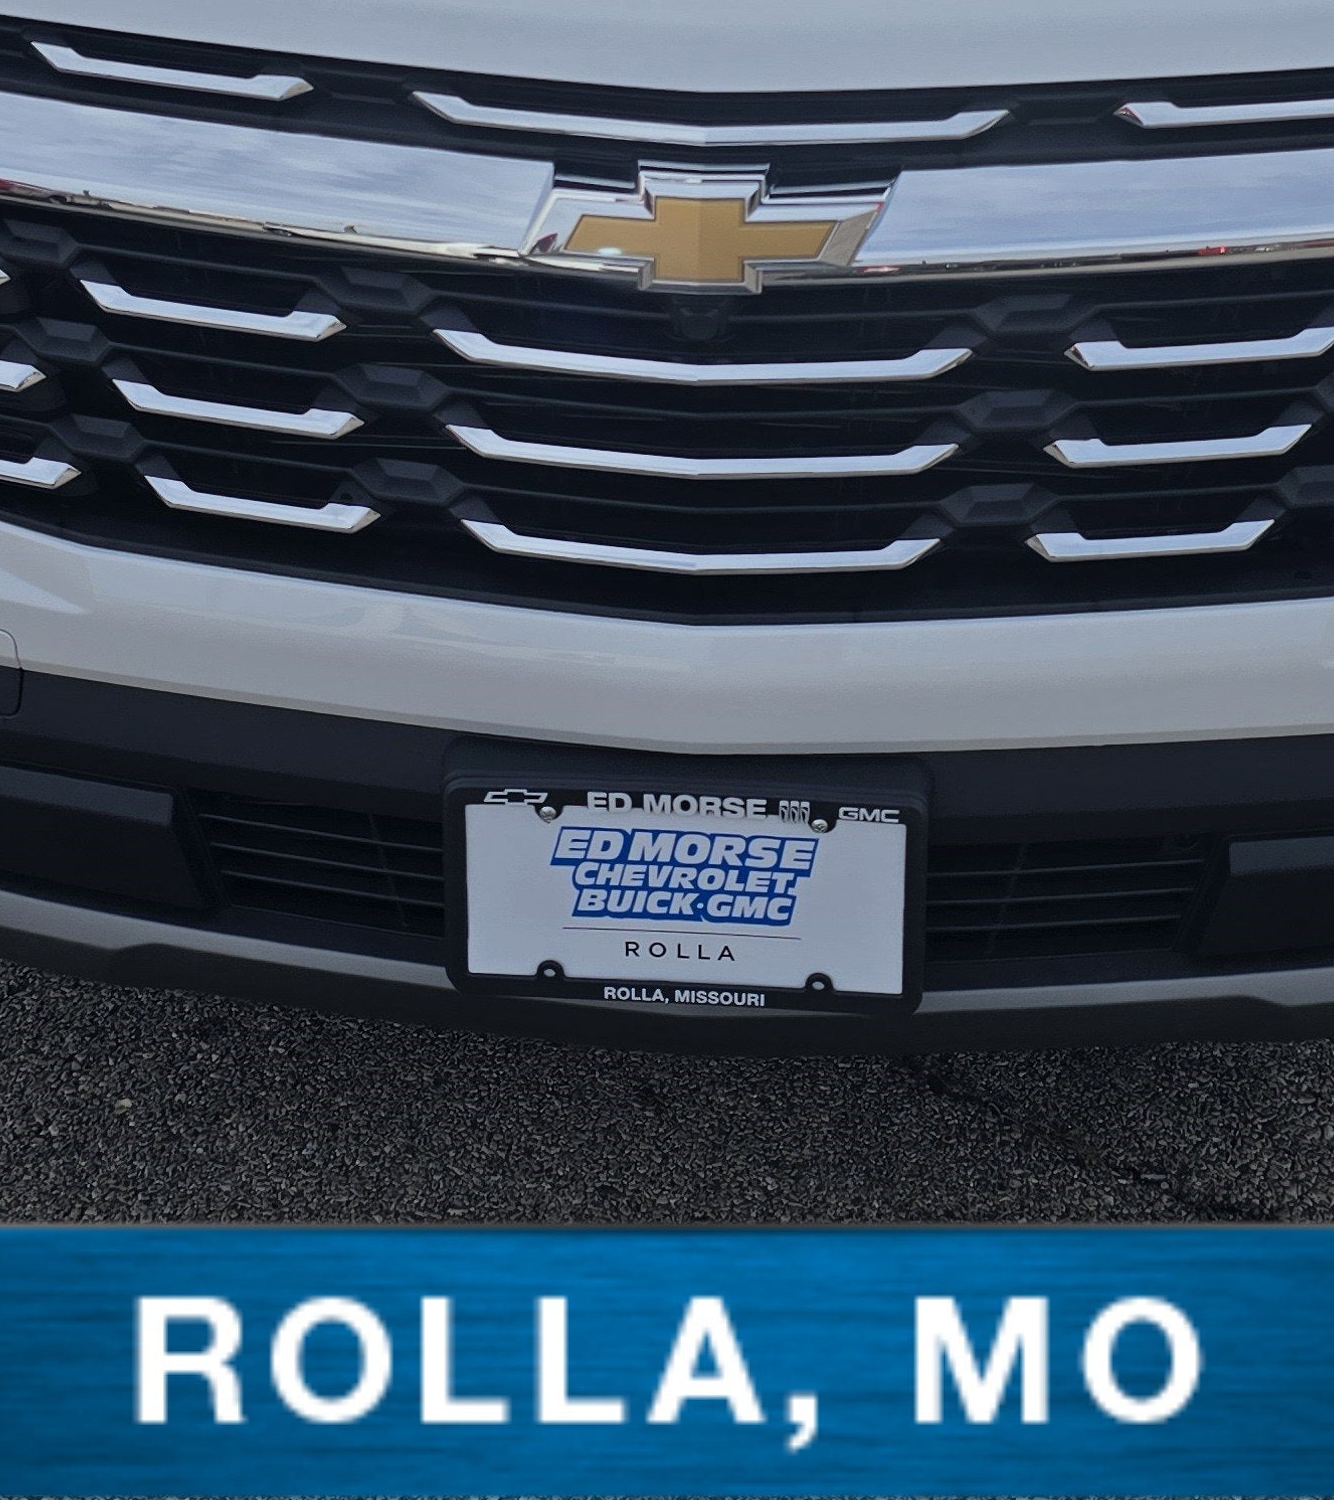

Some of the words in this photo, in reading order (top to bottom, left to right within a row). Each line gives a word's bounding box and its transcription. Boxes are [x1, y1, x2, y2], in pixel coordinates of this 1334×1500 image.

[587, 791, 633, 814] ED
[643, 794, 768, 820] MORSE
[838, 806, 901, 823] GMC
[554, 829, 624, 860] ED
[627, 831, 817, 871] MORSE
[574, 861, 795, 895] CHEVROLET
[624, 941, 736, 962] ROLLA
[603, 986, 670, 1004] ROLLA,
[674, 989, 766, 1008] MISSOURI
